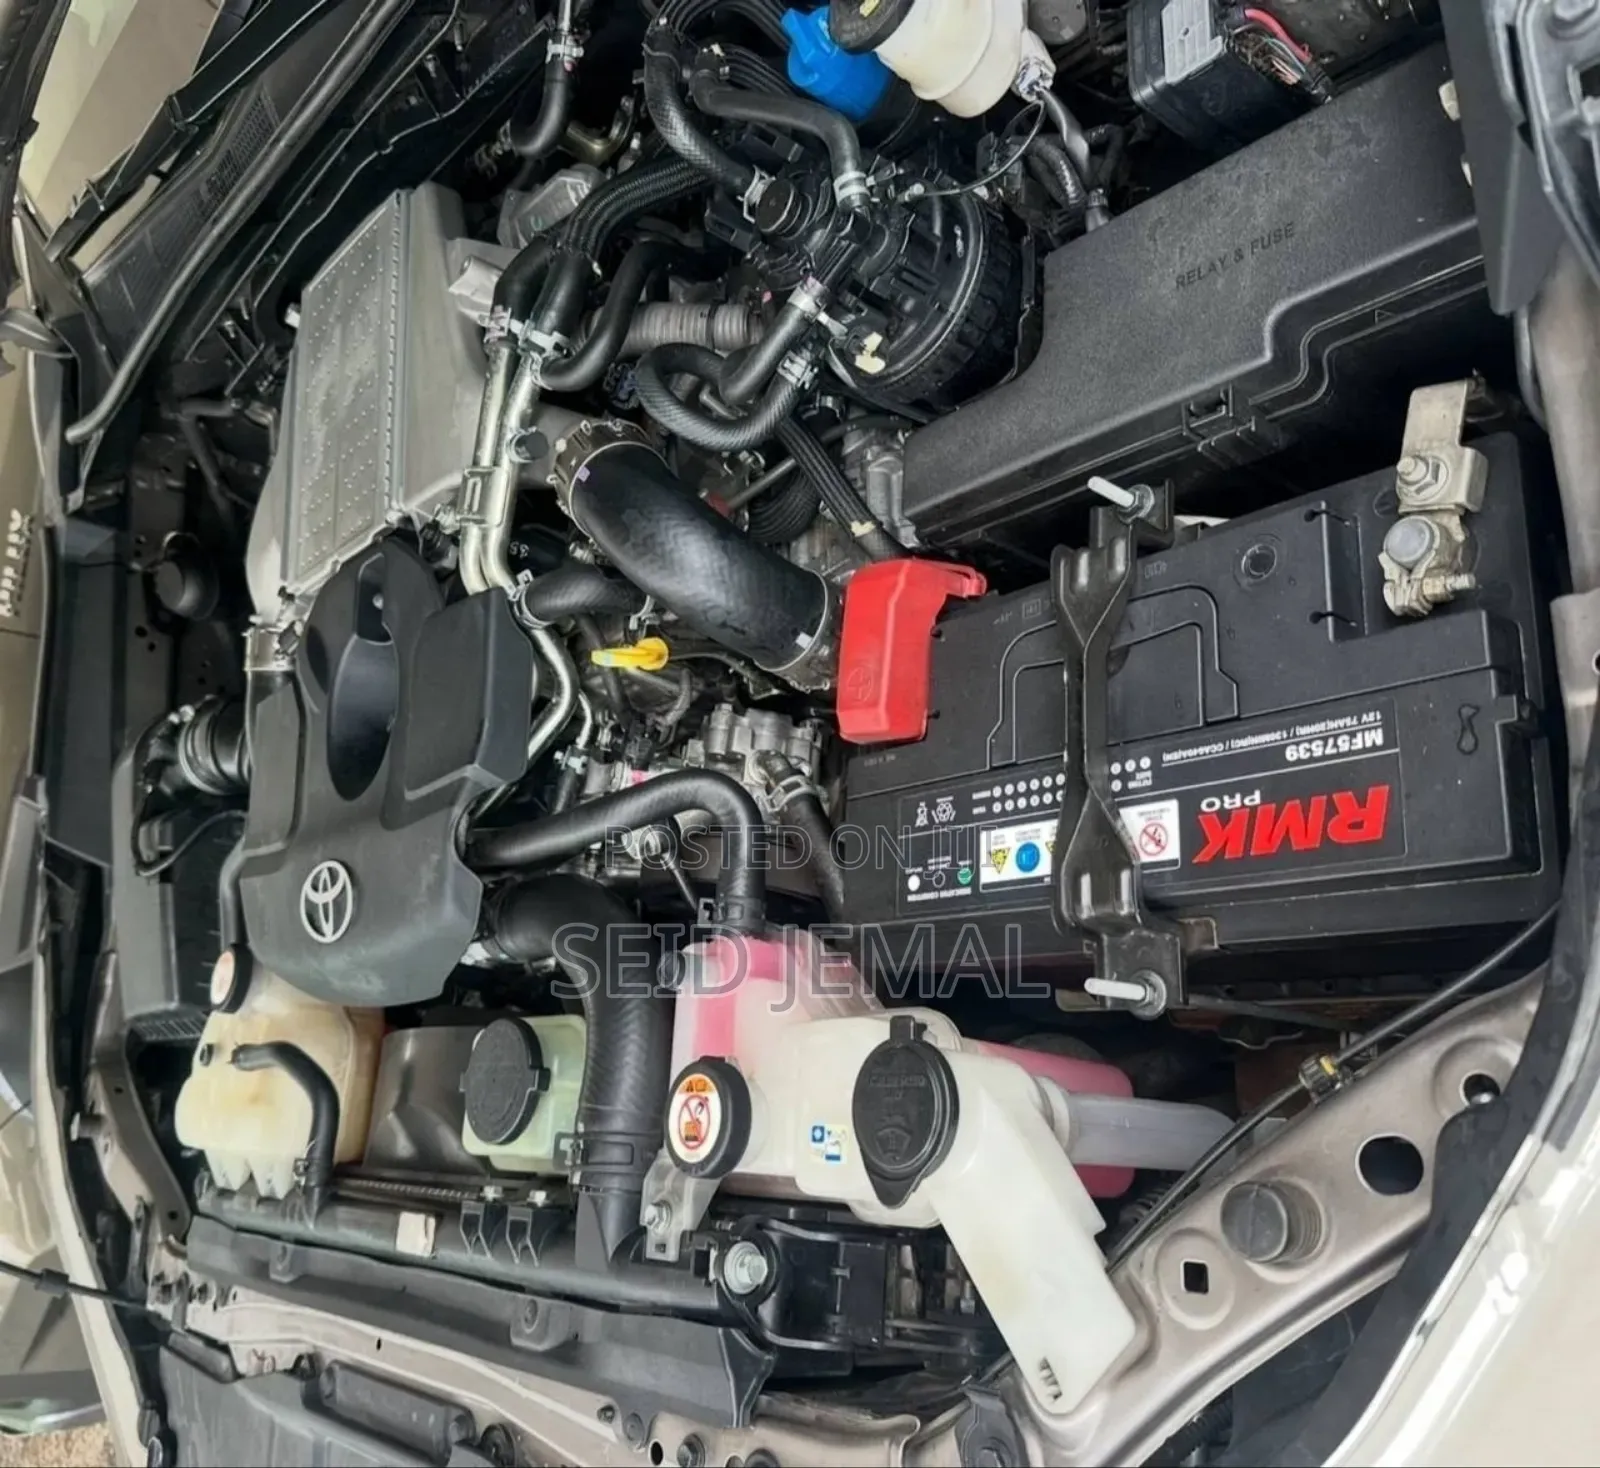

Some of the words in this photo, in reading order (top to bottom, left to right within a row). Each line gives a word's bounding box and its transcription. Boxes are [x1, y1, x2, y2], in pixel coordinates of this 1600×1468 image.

[1175, 253, 1227, 289] RELAY
[1234, 248, 1244, 263] &
[1250, 221, 1294, 255] FUSE
[1285, 728, 1384, 762] MF57539
[1192, 785, 1391, 864] RMK
[1200, 789, 1261, 812] PRO
